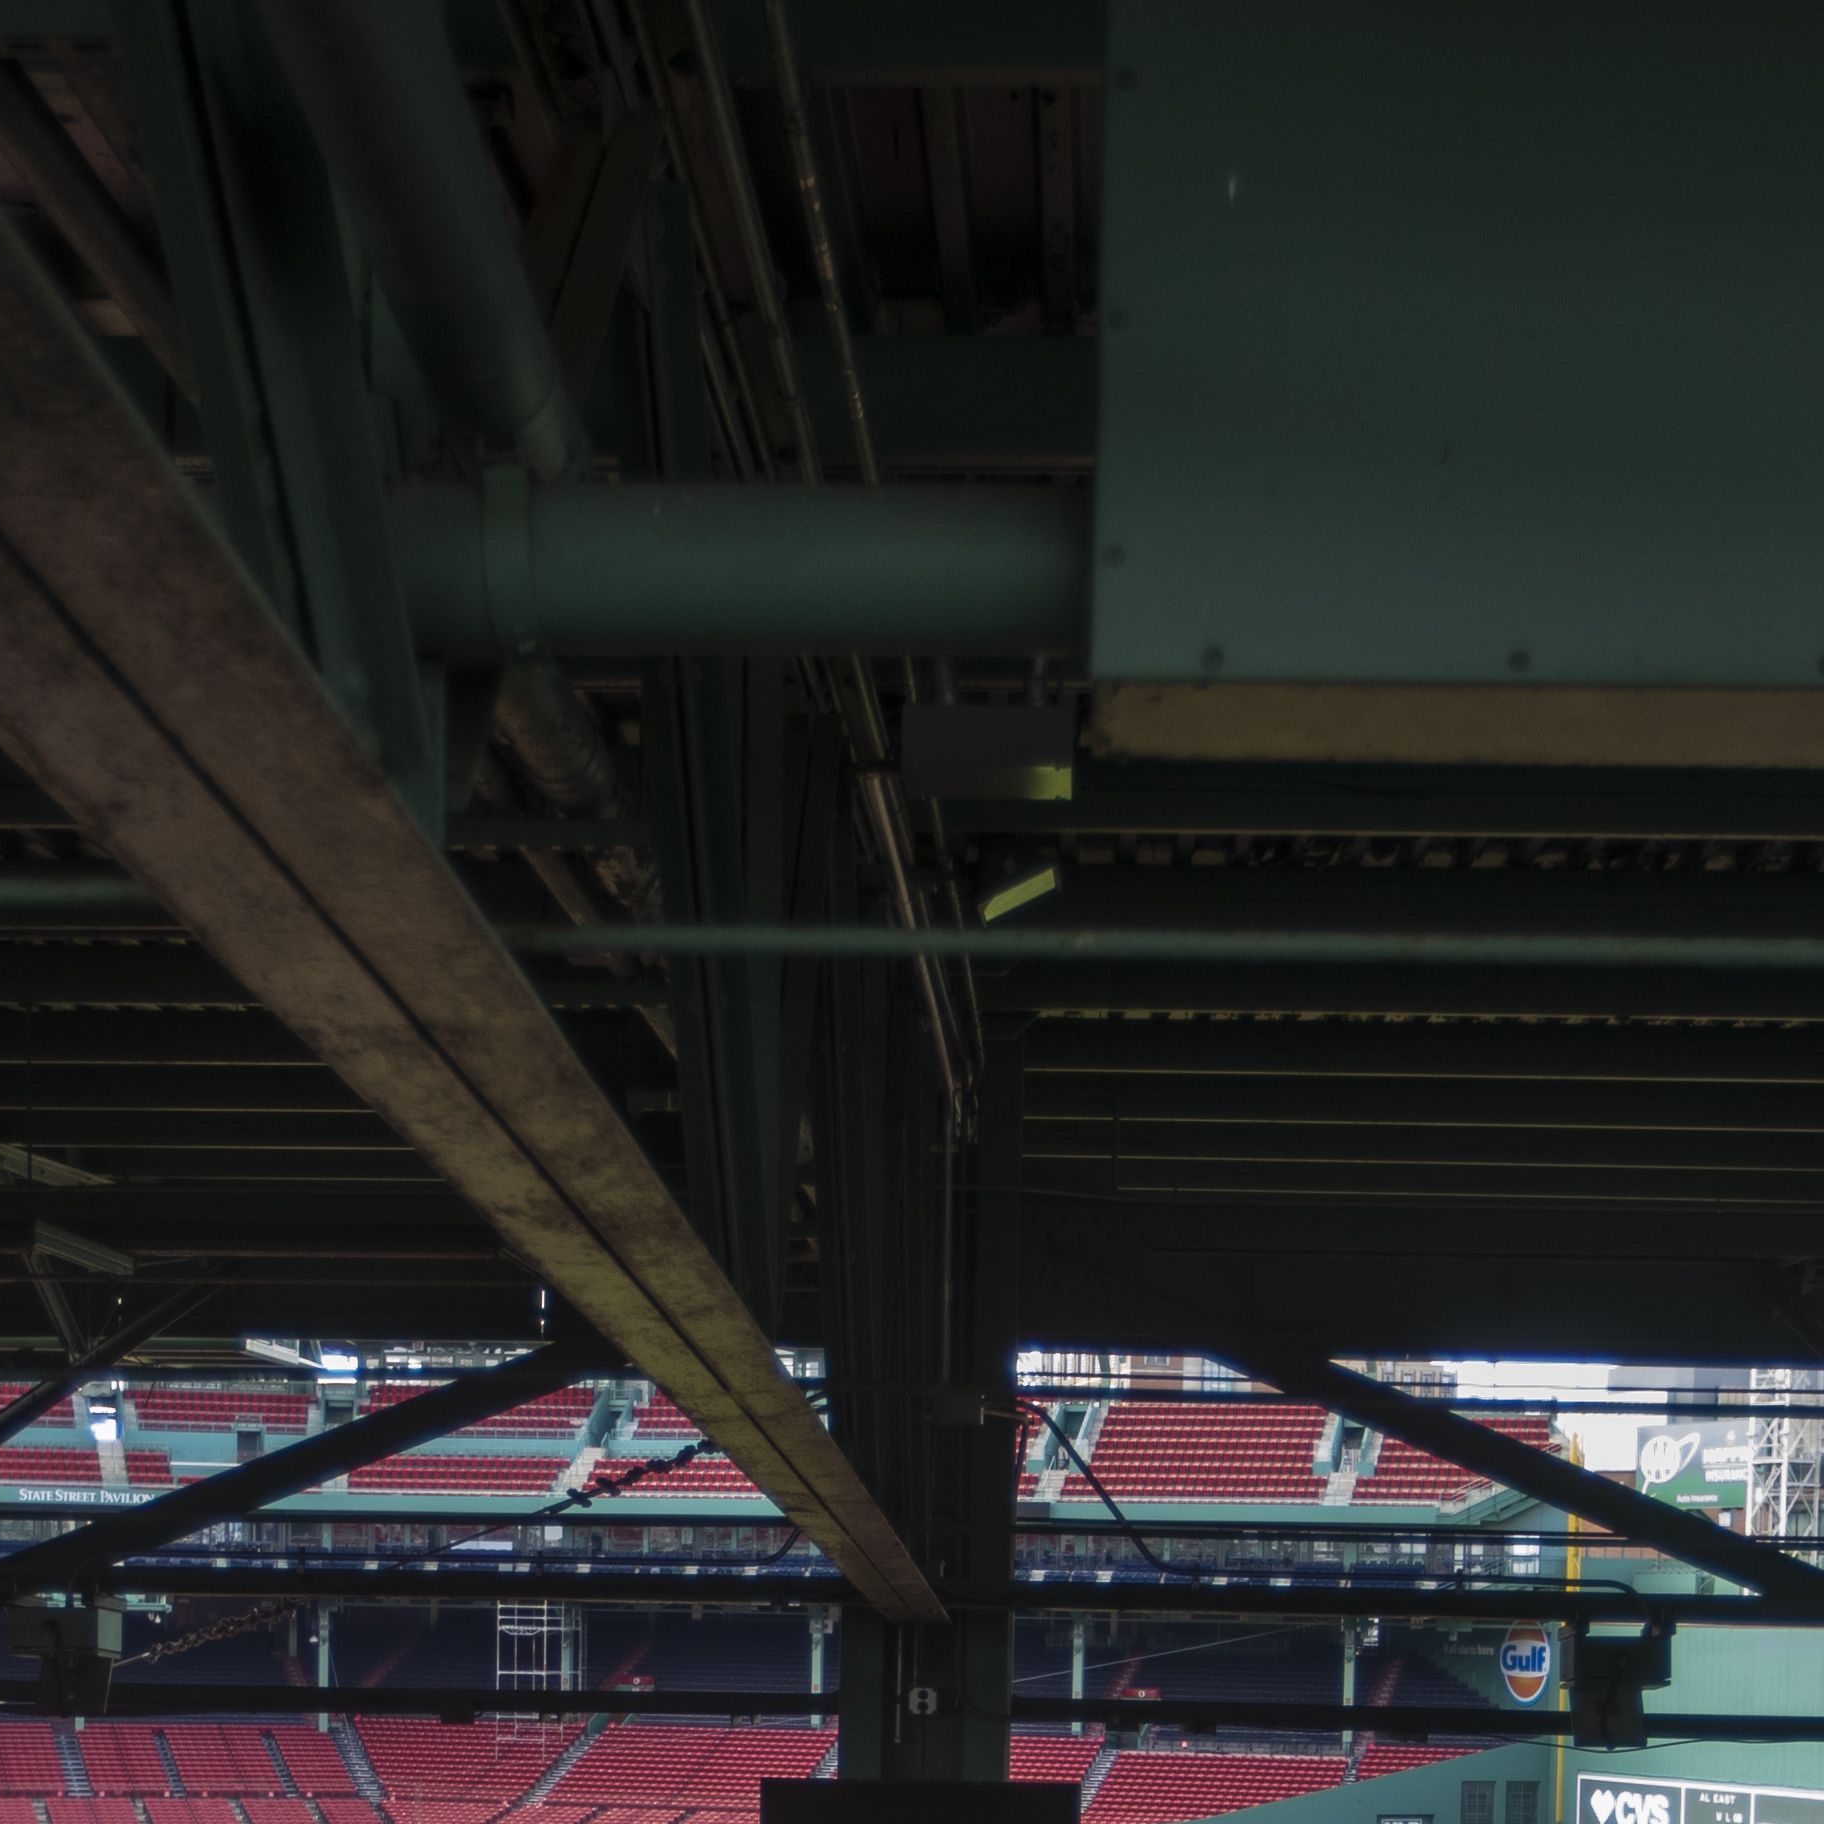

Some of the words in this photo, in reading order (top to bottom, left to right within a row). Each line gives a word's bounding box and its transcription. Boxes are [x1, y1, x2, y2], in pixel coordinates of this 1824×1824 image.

[19, 1488, 53, 1501] STATE
[55, 1489, 96, 1502] STREET
[1477, 1644, 1495, 1656] here
[1501, 1644, 1547, 1673] Gulf
[1699, 1792, 1711, 1803] AL
[1713, 1794, 1736, 1806] EAST
